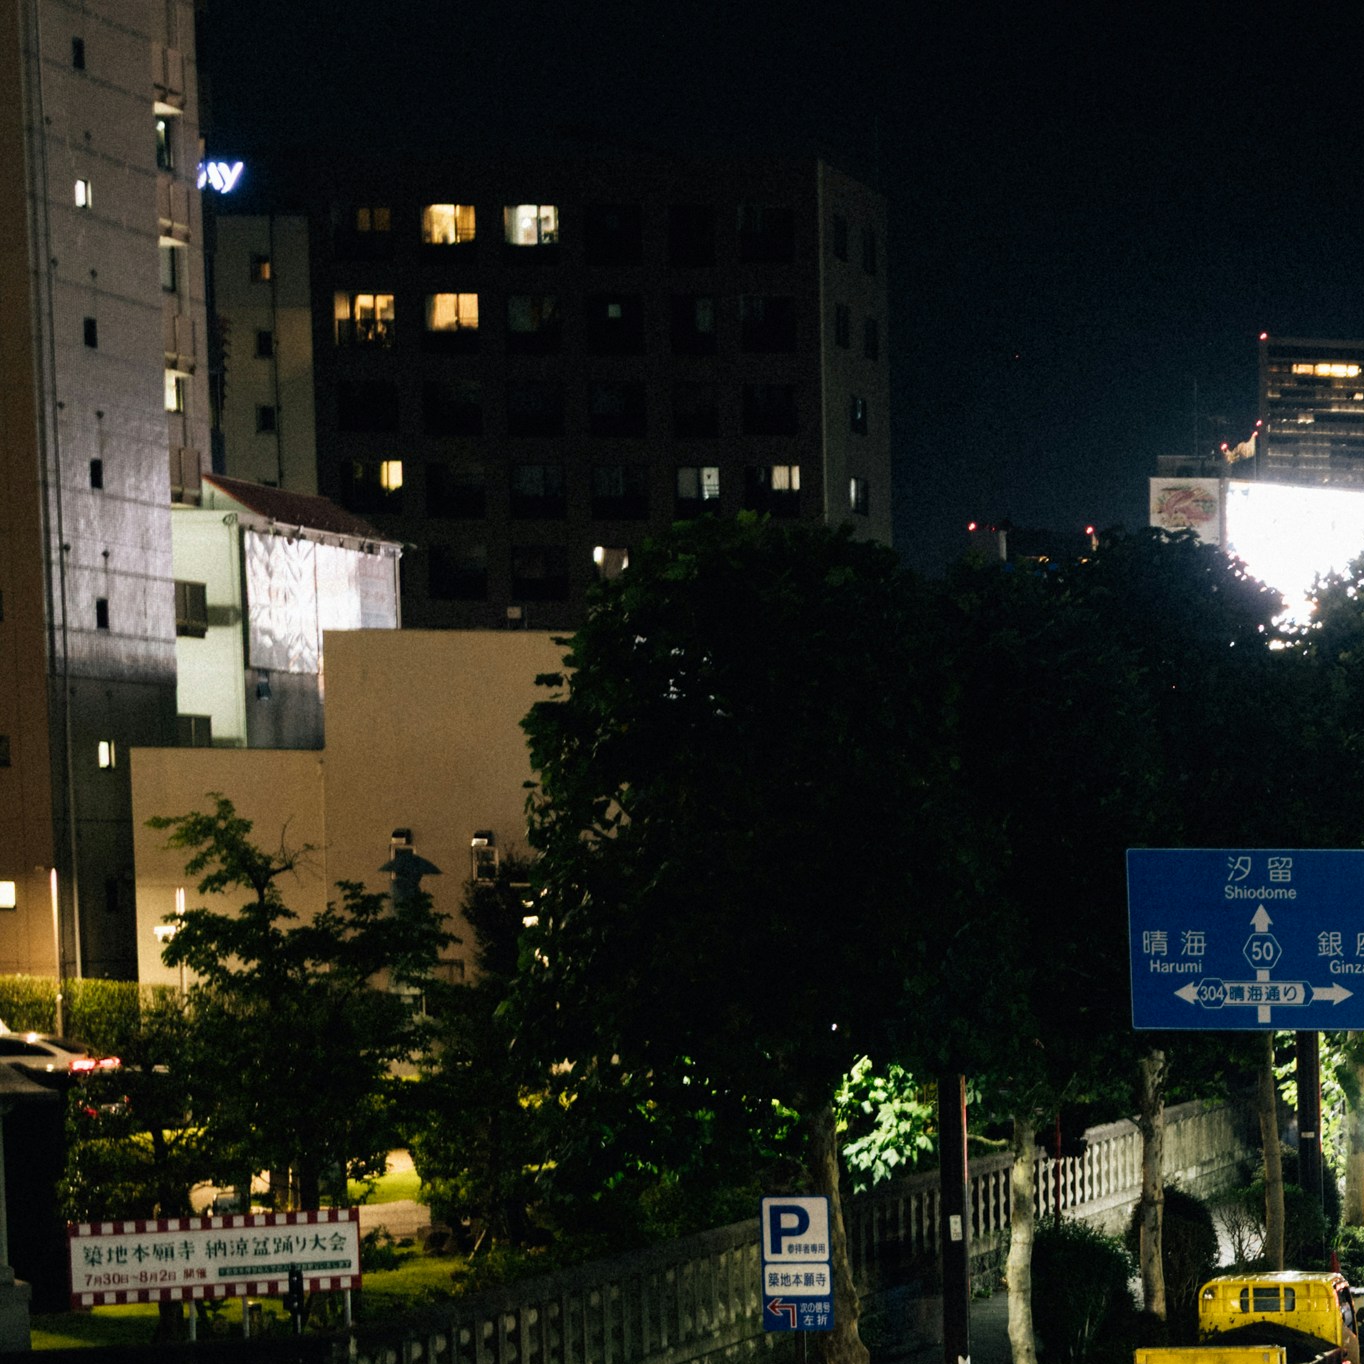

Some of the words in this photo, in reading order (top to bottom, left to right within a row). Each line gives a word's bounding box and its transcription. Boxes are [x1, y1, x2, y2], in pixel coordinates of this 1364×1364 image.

[1227, 856, 1293, 882] 汐留
[1224, 885, 1297, 900] Shiodome
[1143, 930, 1207, 956] 晴海
[1251, 942, 1274, 960] 50
[1150, 960, 1202, 973] Harumi
[1200, 986, 1225, 1001] 304
[1229, 985, 1297, 1002] 晴海通り
[769, 1204, 810, 1255] P
[83, 1239, 196, 1267] 築地本願寺
[204, 1231, 348, 1259] 納涼盆踊り大会
[787, 1243, 826, 1255] 参拝者専用
[768, 1272, 827, 1287] 築地本願寺
[800, 1302, 831, 1313] 次の信号
[803, 1314, 828, 1326] 左折
